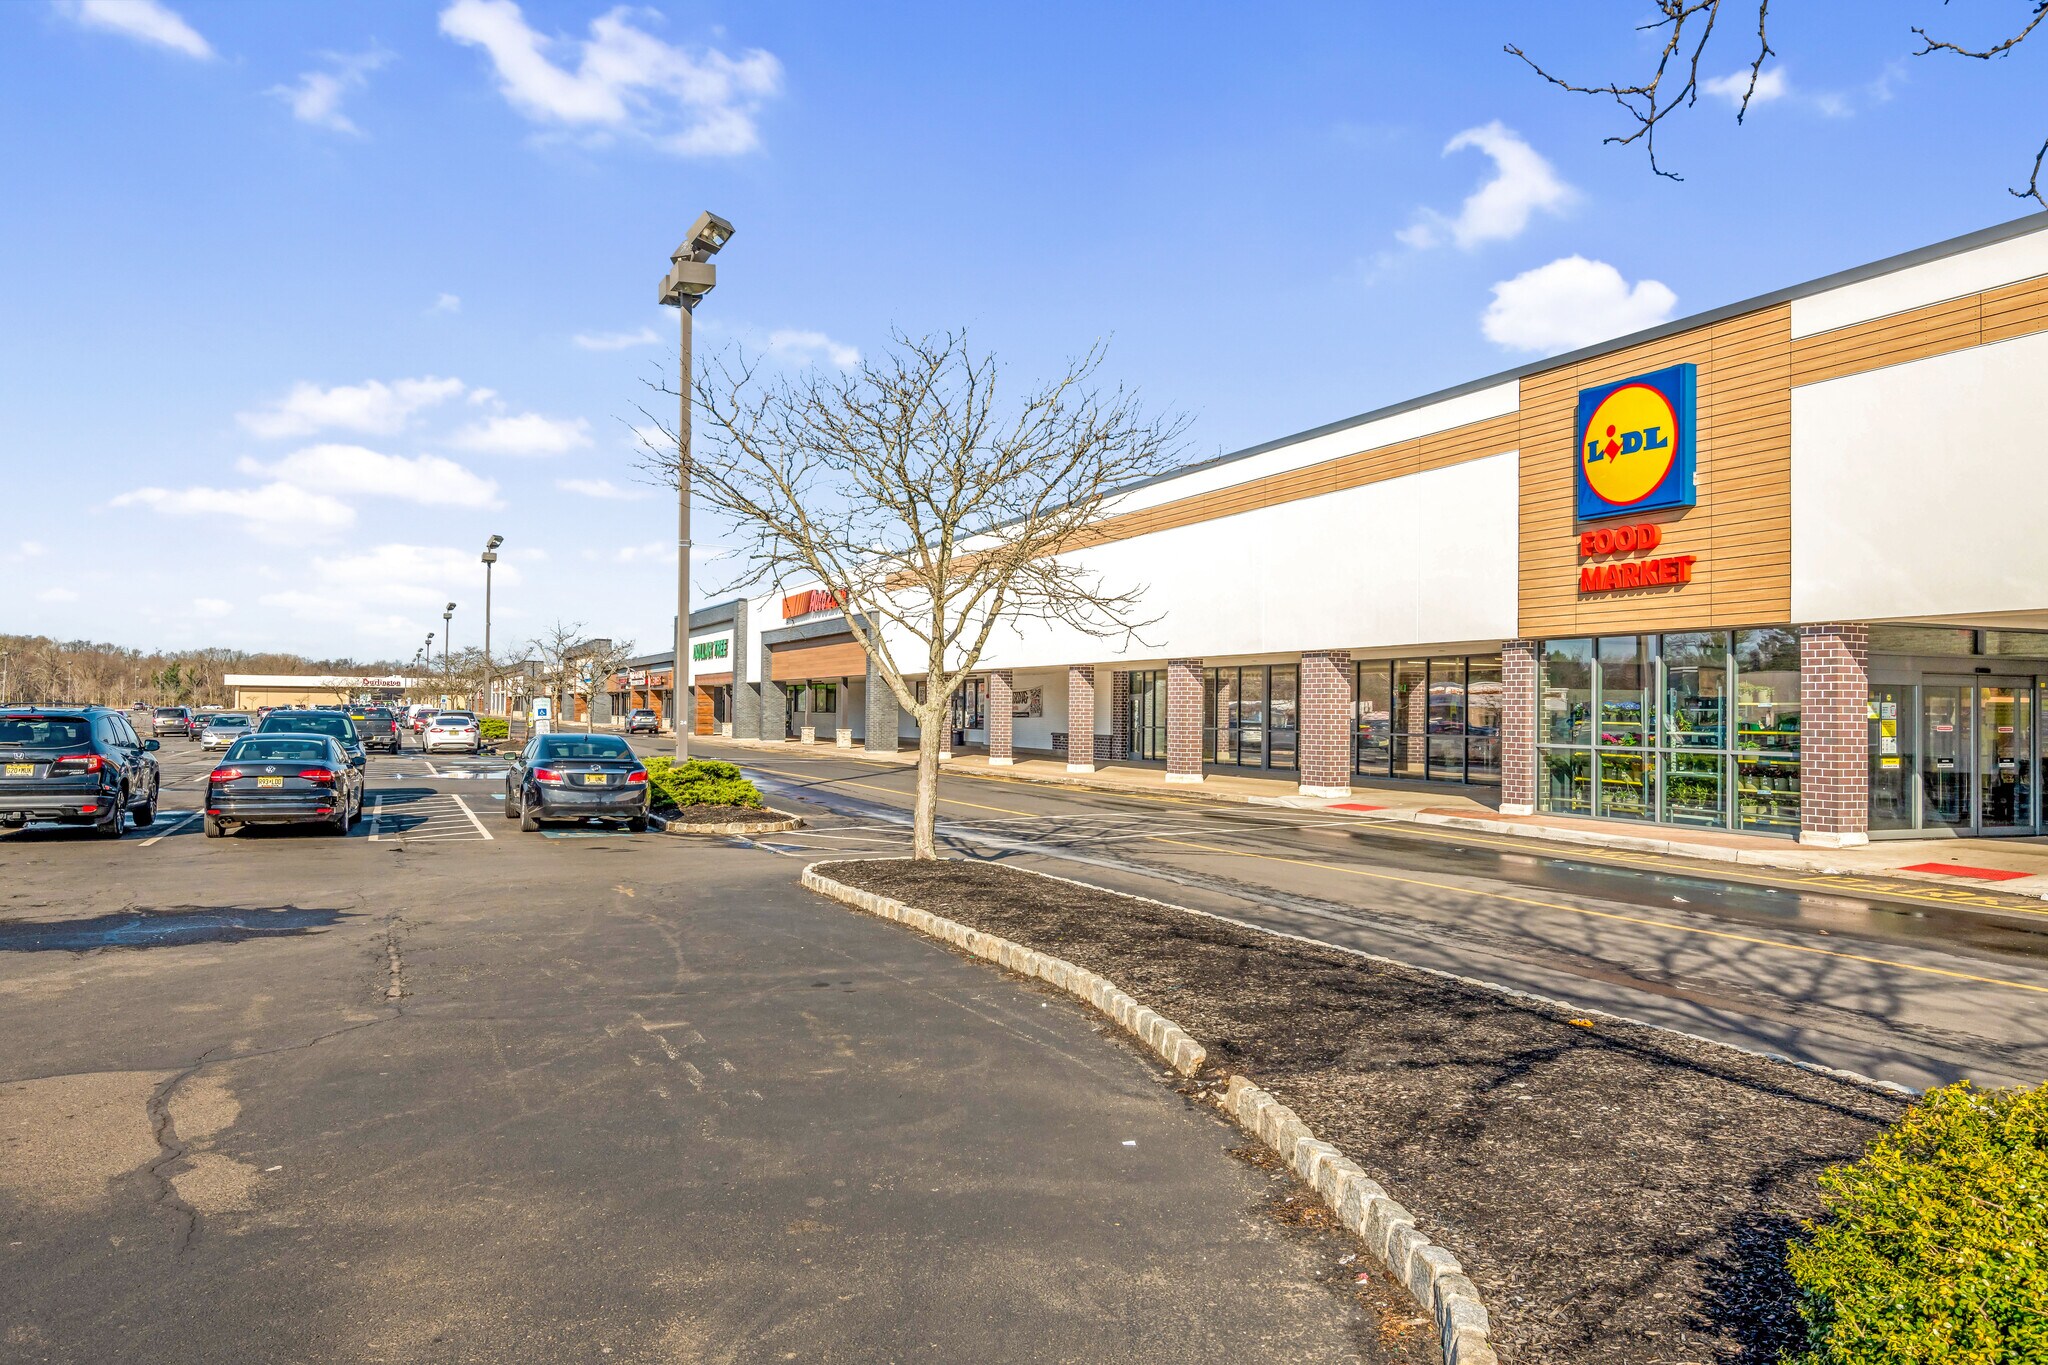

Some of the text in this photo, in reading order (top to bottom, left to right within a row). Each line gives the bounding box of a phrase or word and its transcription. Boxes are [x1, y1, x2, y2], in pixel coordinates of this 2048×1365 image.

[1580, 523, 1662, 557] FOOD
[1580, 555, 1697, 593] MARKET
[714, 639, 729, 657] TREE
